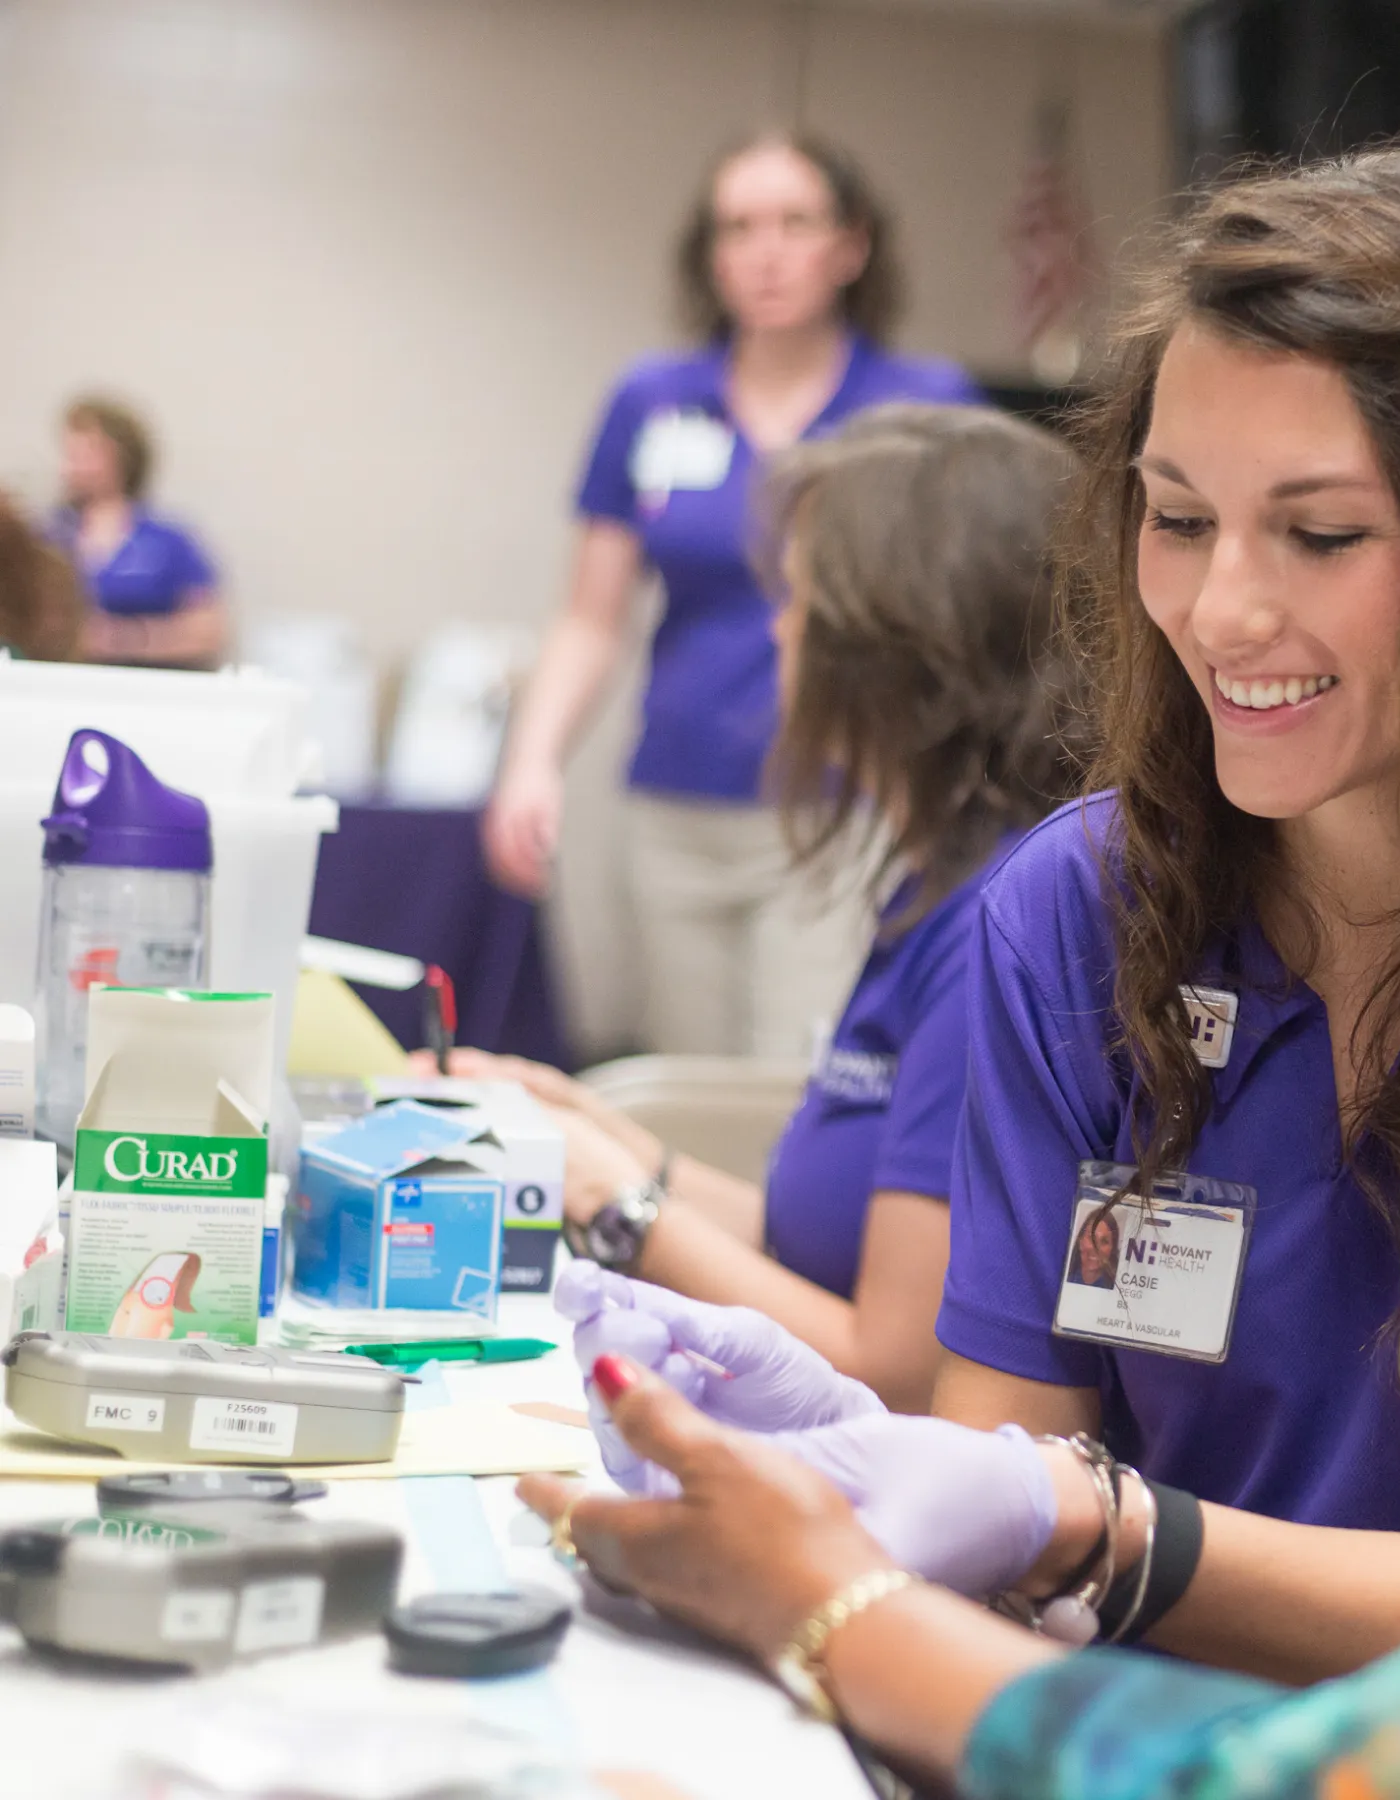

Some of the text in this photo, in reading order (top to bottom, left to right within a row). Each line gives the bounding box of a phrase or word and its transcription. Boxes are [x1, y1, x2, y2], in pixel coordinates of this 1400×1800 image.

[1161, 1243, 1213, 1261] NOVANT
[1158, 1255, 1206, 1273] HEALTH
[1121, 1272, 1159, 1290] CASIE
[1096, 1316, 1125, 1329] HEART
[1135, 1322, 1182, 1338] VASCULAR
[94, 1406, 158, 1423] FMC 9
[226, 1403, 268, 1416] F25609
